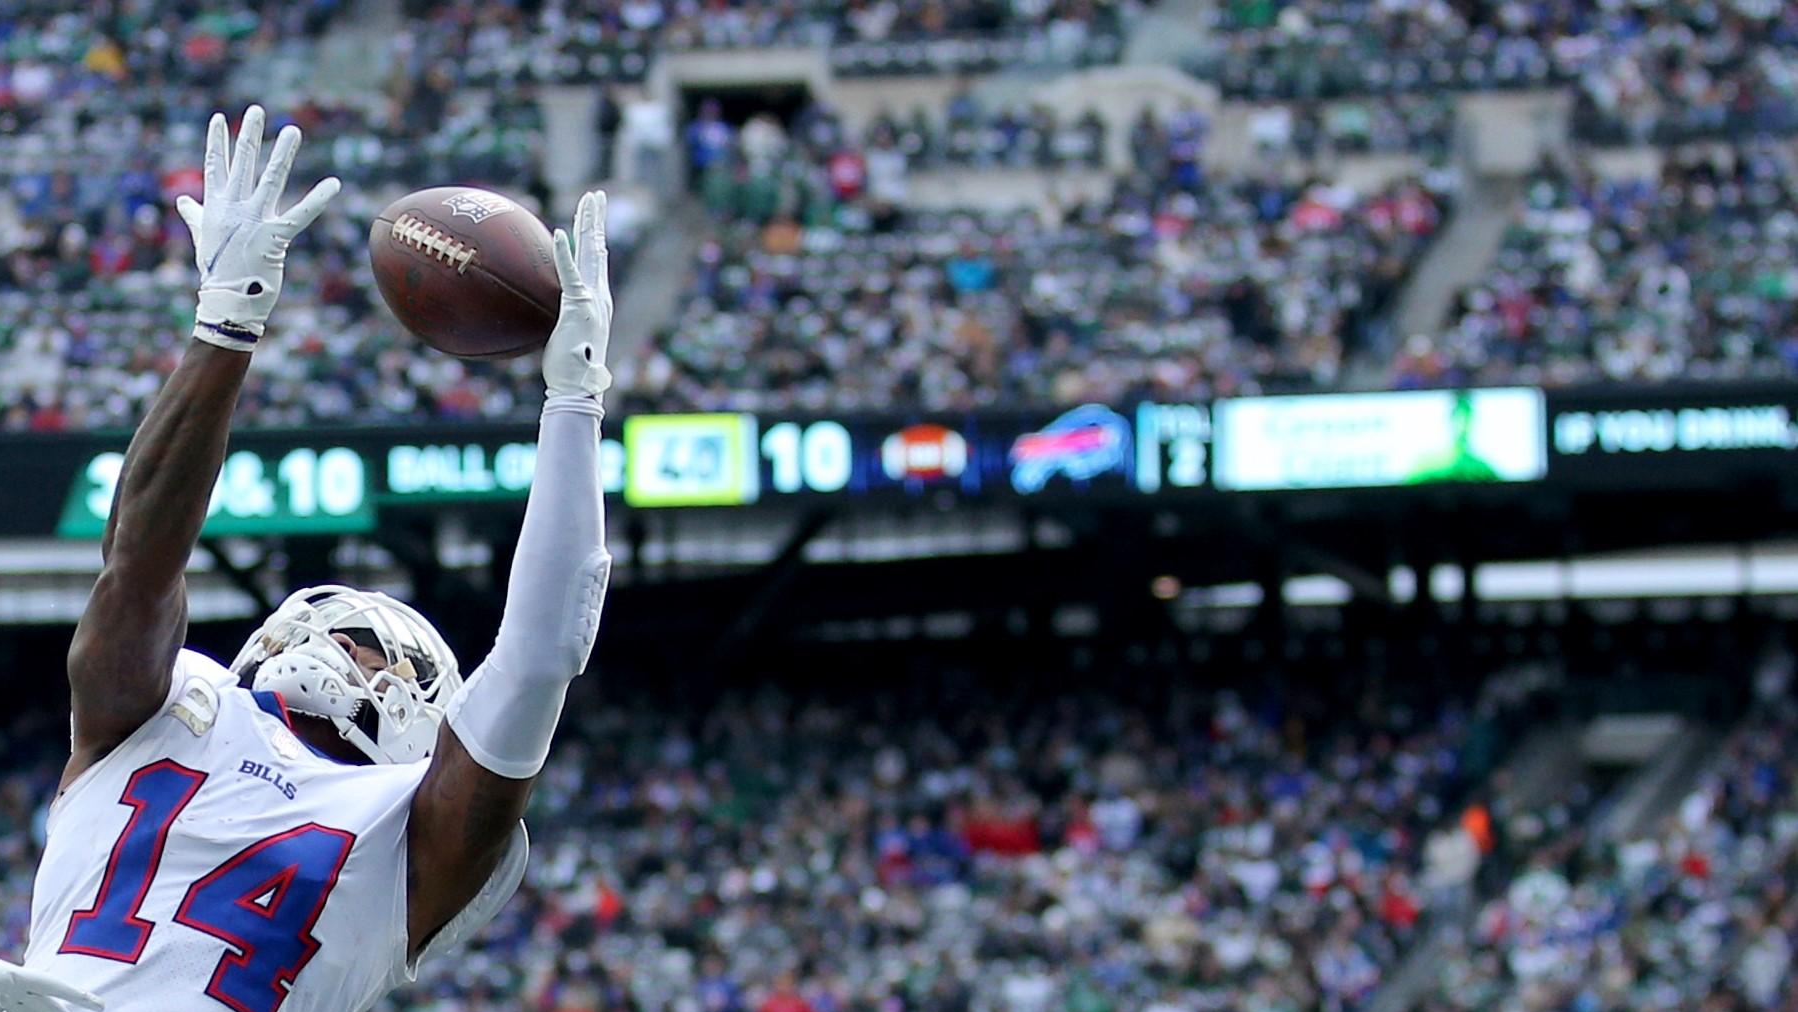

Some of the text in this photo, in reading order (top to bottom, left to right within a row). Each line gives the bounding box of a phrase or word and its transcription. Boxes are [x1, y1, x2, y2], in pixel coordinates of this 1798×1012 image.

[1596, 408, 1676, 453] YOU
[387, 443, 495, 493] BALL
[762, 420, 853, 493] 10
[224, 450, 276, 518] &
[278, 446, 365, 518] 10
[238, 758, 297, 800] BILLS
